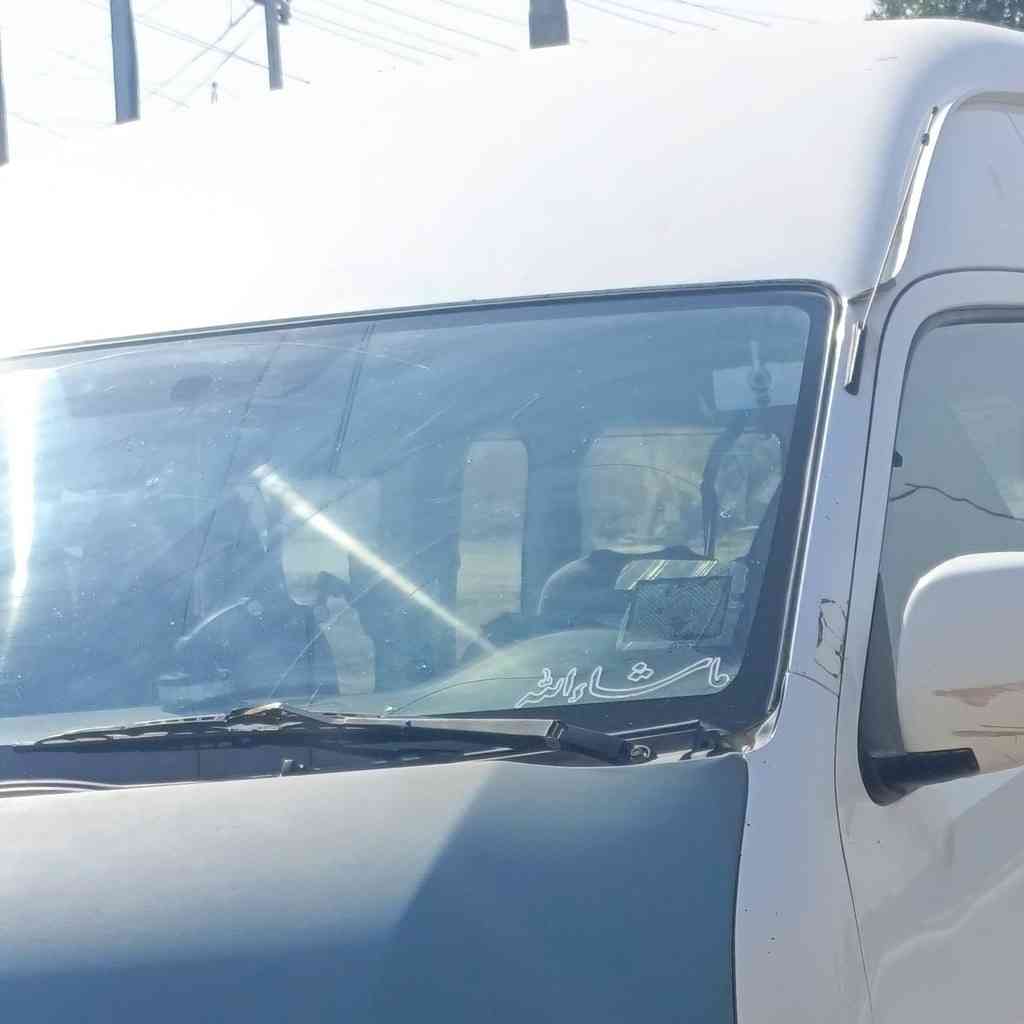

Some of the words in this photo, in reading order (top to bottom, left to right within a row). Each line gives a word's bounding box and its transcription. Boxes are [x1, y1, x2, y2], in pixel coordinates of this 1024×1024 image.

[513, 666, 577, 709] الله
[567, 656, 714, 703] شاء
[708, 656, 730, 688] ما
